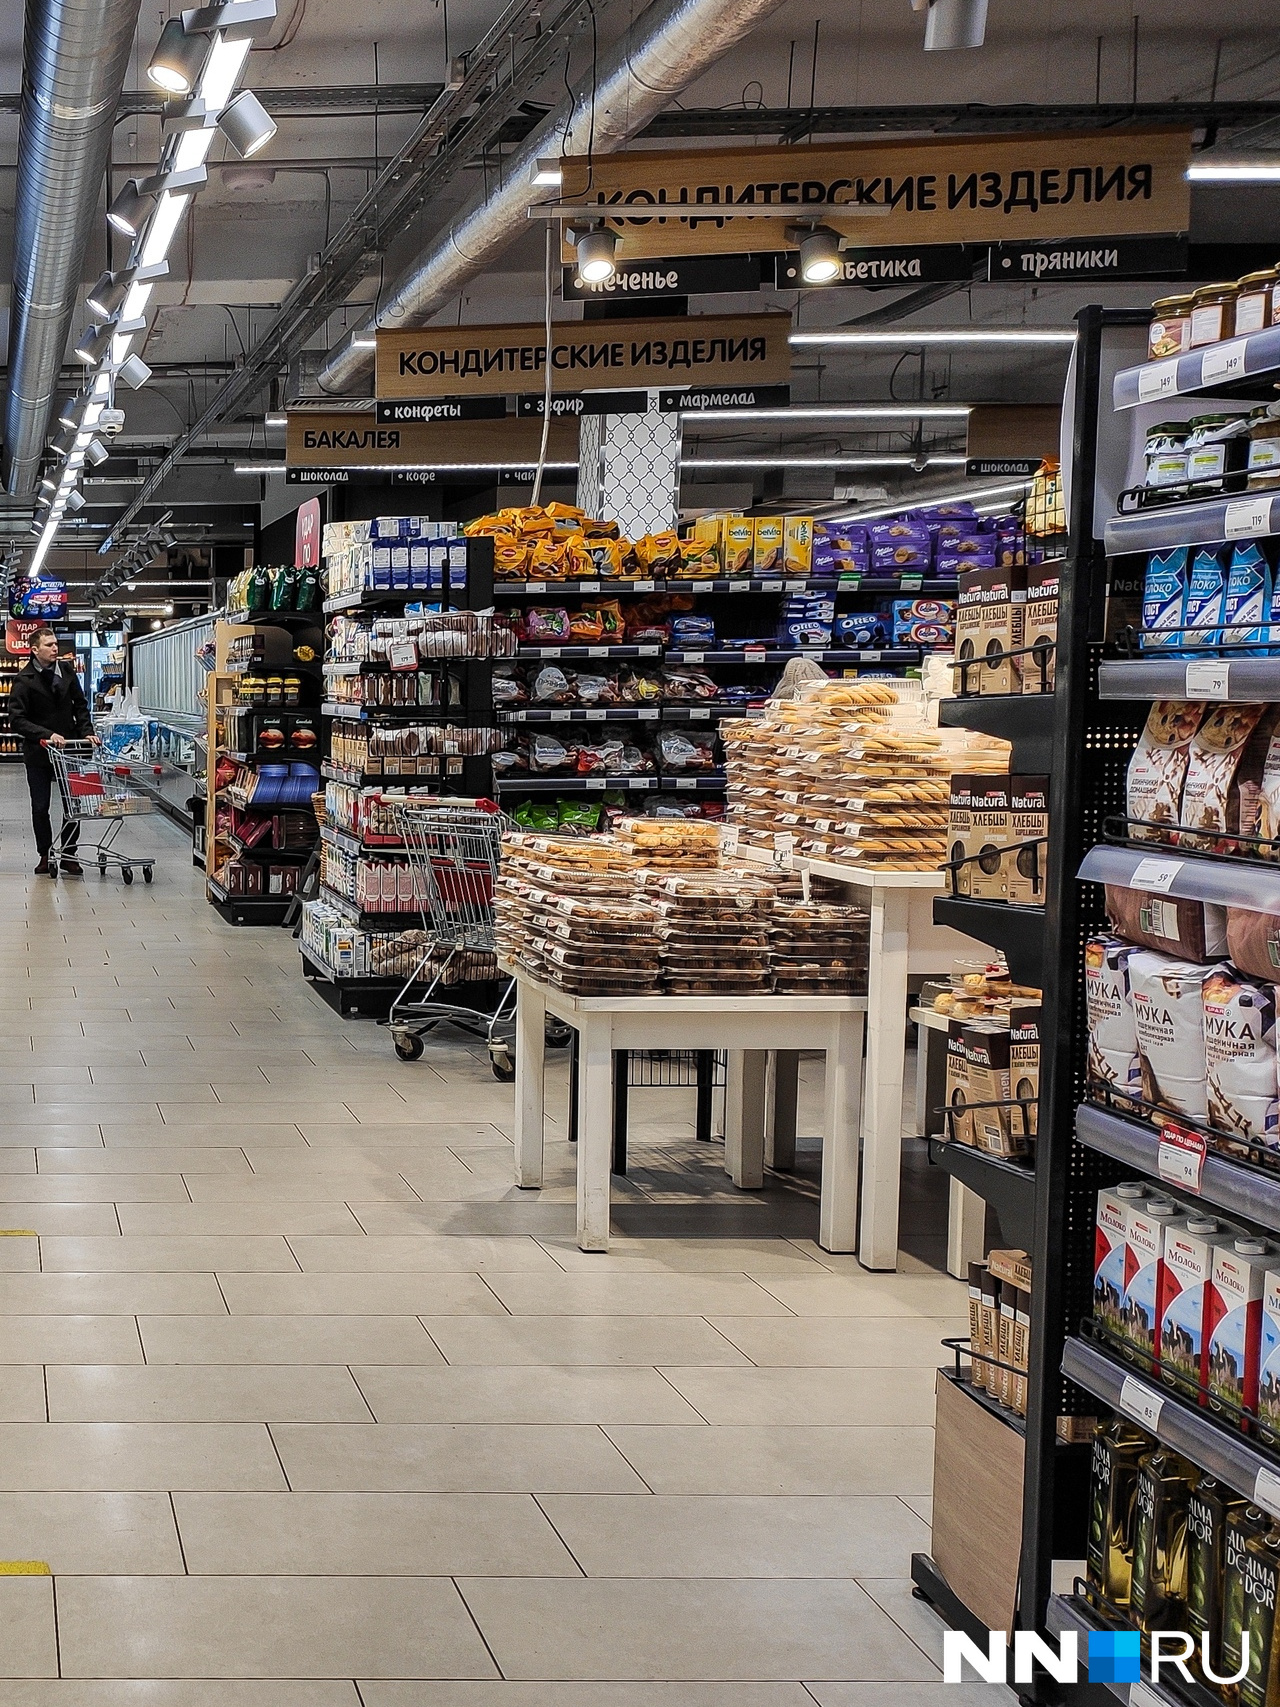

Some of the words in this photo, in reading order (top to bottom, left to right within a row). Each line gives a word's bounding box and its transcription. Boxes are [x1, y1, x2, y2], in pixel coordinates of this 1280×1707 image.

[596, 174, 937, 229] КОНДИТЕРСКИЕ
[947, 164, 1153, 214] ИЗДЕЛИЯ
[828, 258, 921, 281] абетика
[1020, 249, 1118, 278] пряники
[398, 343, 624, 378] КОНДИТЕРСКИЕ
[630, 337, 767, 367] ИЗДЕЛИЯ
[1225, 356, 1238, 371] 149
[679, 392, 756, 410] мармелад
[394, 403, 462, 421] конфеты
[304, 430, 401, 450] БАКАЛЕЯ
[979, 459, 1030, 474] шоколад
[405, 470, 436, 484] кофе
[513, 469, 535, 482] чай
[1251, 515, 1263, 526] 119
[958, 588, 982, 604] Natura
[981, 586, 1009, 603] Natural
[1027, 583, 1059, 599] Natura
[841, 615, 877, 629] OREO
[982, 606, 1008, 621] ХЛЕБЦЫ
[789, 620, 820, 634] OREO
[1011, 607, 1023, 646] ХЛЕБЦЫ
[11, 641, 30, 649] ЦЕН
[1212, 680, 1222, 690] 79
[950, 793, 971, 806] Natura
[971, 794, 1008, 808] Natural
[1011, 796, 1046, 809] Natural
[972, 813, 1008, 827] ХЛЕБЦЫ
[1011, 815, 1045, 828] ХЛЕБЦЫ
[1157, 873, 1169, 882] 59
[1087, 979, 1121, 1001] МУКА
[1135, 1002, 1174, 1026] МУКА
[1010, 1026, 1040, 1041] Natural
[1206, 1016, 1256, 1041] МУКА
[948, 1038, 966, 1054] Natu
[1011, 1045, 1039, 1060] ХЛЕБЦЫ
[948, 1056, 968, 1073] ХЛЕБЦ
[965, 1047, 991, 1065] Natural
[1183, 1166, 1193, 1177] 94
[1100, 1210, 1127, 1233] Молоко
[1129, 1228, 1156, 1251] Молоко
[1168, 1248, 1202, 1273] Молоко
[1215, 1268, 1245, 1294] Молоко
[1092, 1440, 1111, 1468] ALMA
[1092, 1458, 1111, 1485] DOR
[1137, 1493, 1154, 1520] DOR
[1188, 1496, 1213, 1526] ALMA
[1188, 1518, 1213, 1546] DOR
[1245, 1556, 1276, 1591] ALMA
[1245, 1575, 1275, 1611] DOR
